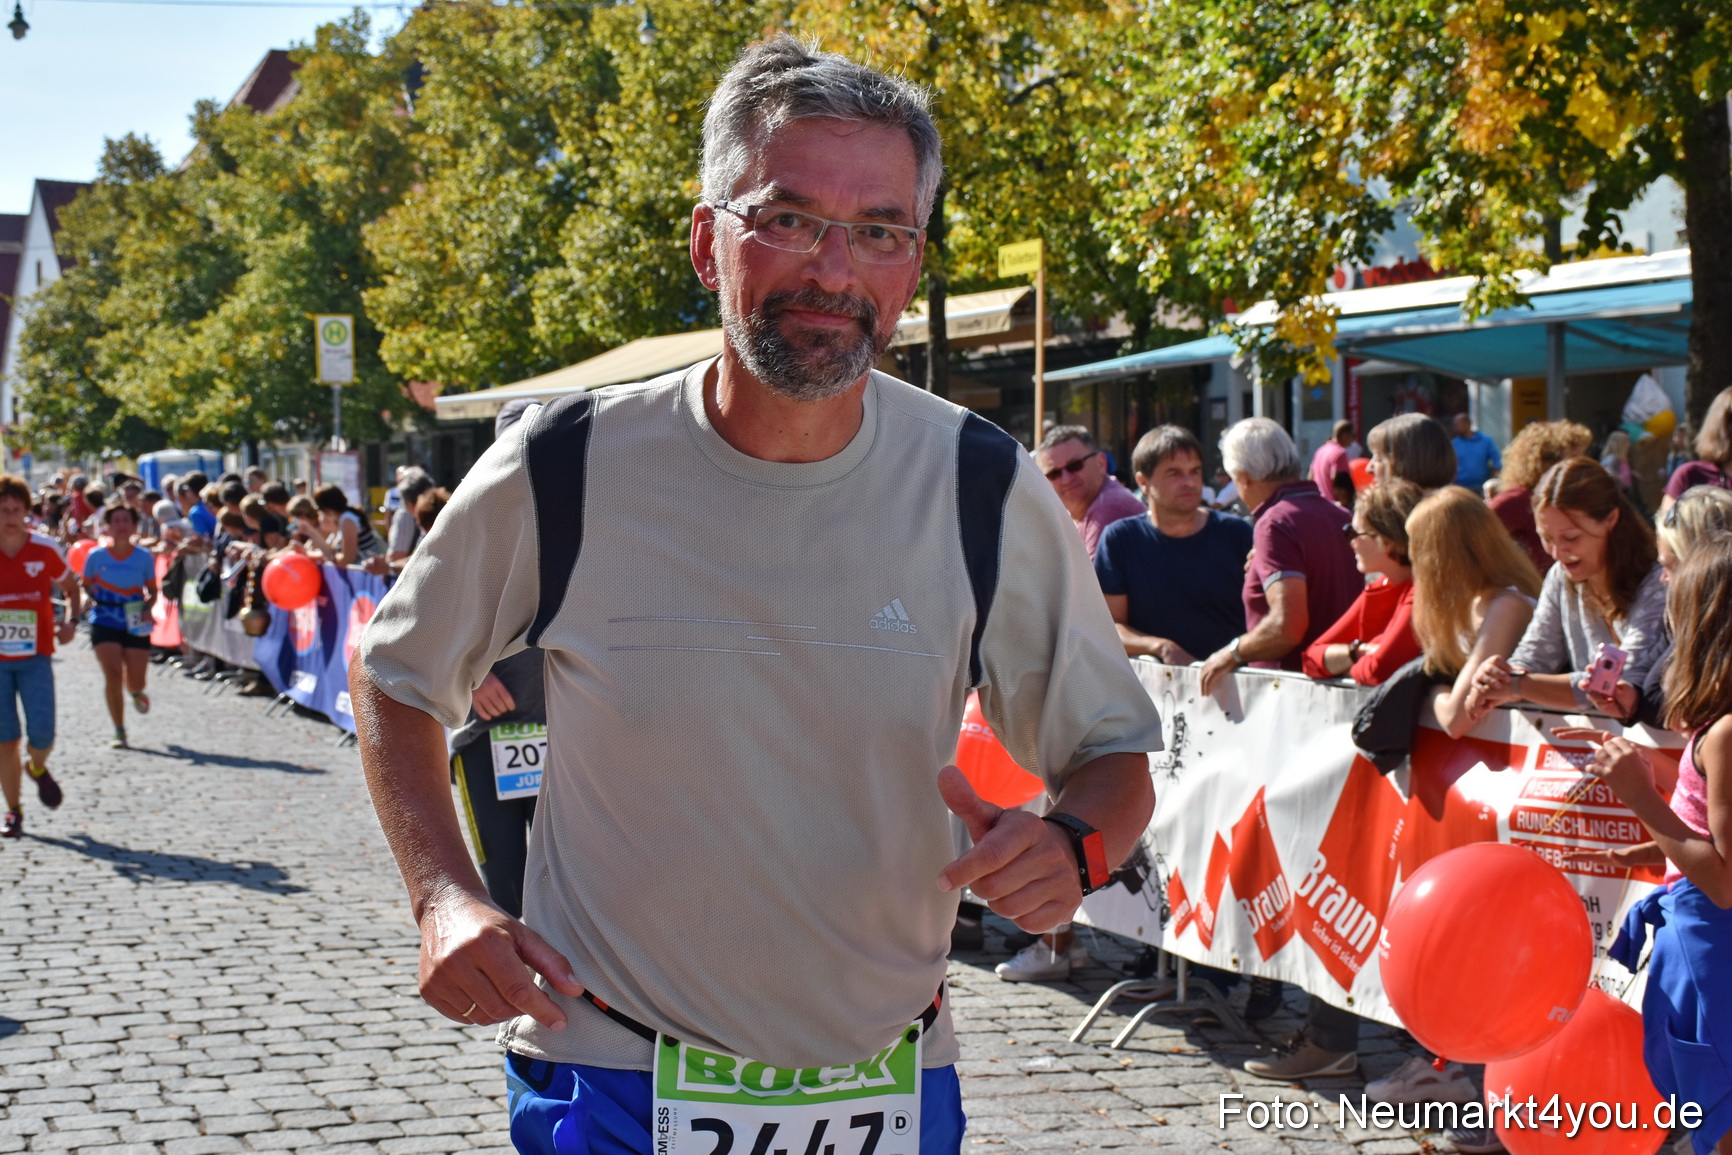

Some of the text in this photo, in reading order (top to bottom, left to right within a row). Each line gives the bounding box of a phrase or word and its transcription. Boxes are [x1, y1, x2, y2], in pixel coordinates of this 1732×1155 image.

[869, 618, 917, 634] adidas
[1516, 810, 1642, 841] RUNDSCHLINGEN
[1239, 874, 1291, 936] Braun
[1296, 852, 1378, 953] Braun
[681, 1038, 898, 1093] BOCK
[690, 1111, 884, 1155] 2447
[895, 1116, 907, 1130] D
